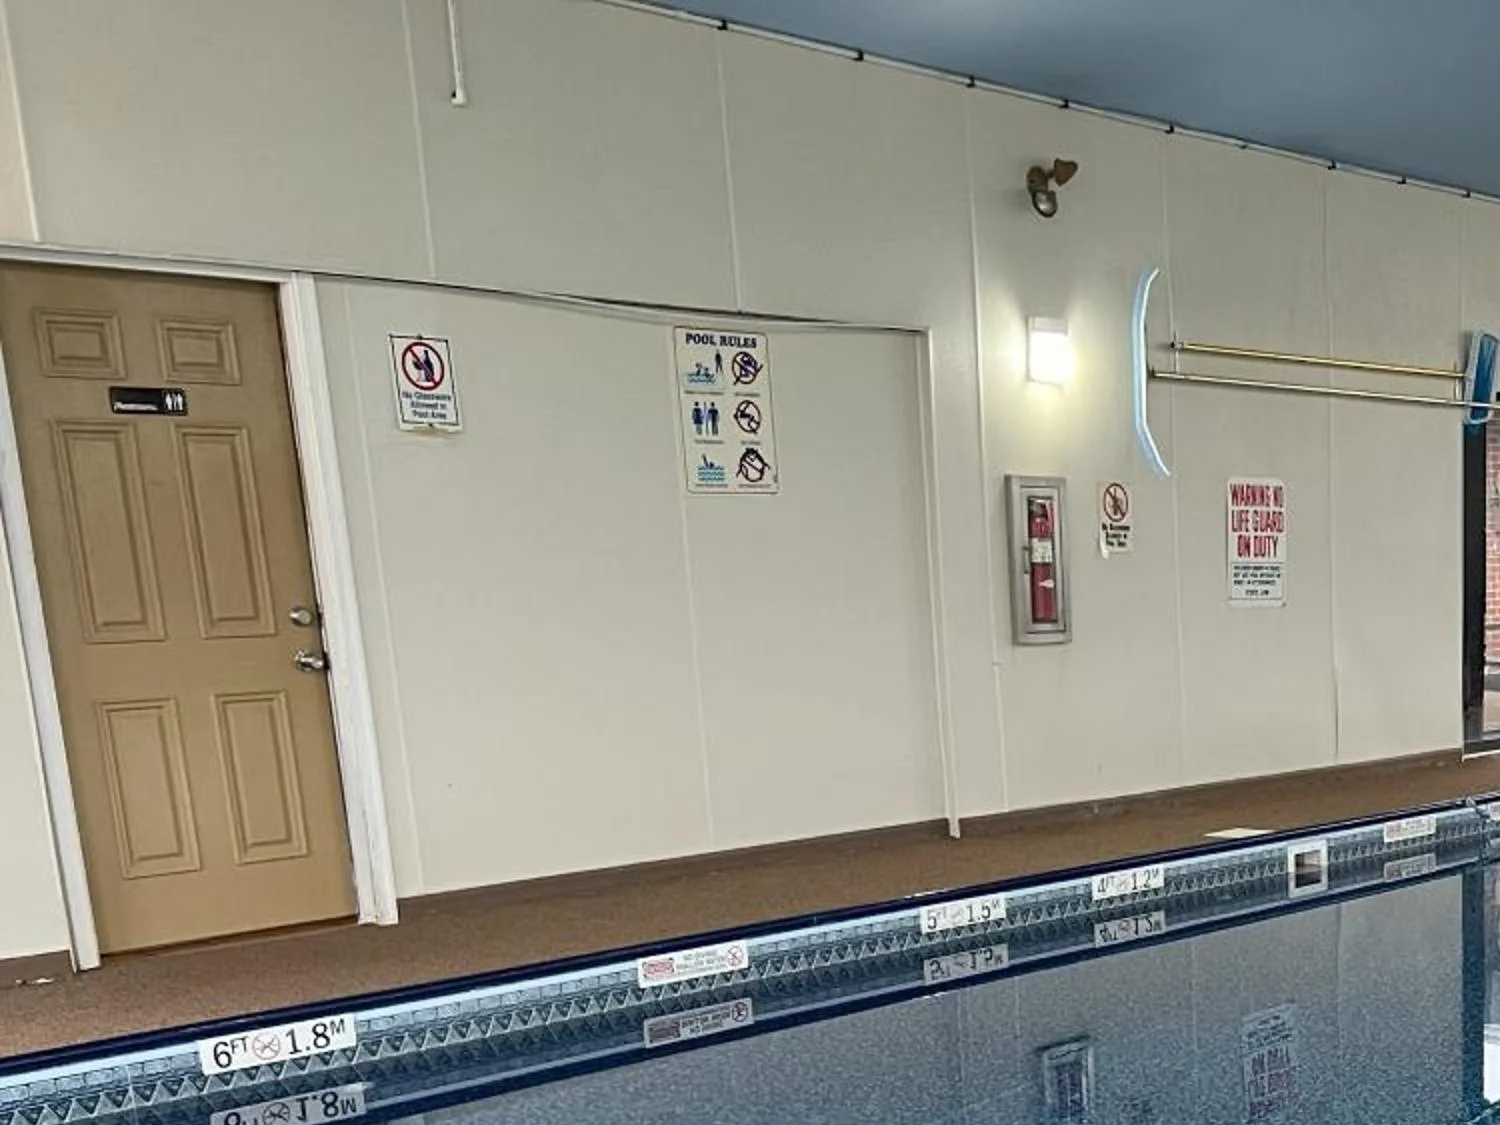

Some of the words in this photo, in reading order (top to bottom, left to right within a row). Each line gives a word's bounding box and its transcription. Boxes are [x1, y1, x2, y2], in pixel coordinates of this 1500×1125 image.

[685, 332, 717, 346] POOL
[720, 335, 757, 349] RULES
[1230, 483, 1271, 507] WARNING
[1232, 509, 1250, 532] LIFE
[1252, 509, 1284, 533] GUARD
[1238, 535, 1251, 557] ON
[1253, 535, 1279, 558] DUTY
[213, 1036, 248, 1069] 6FT
[285, 1018, 345, 1055] 1.8M
